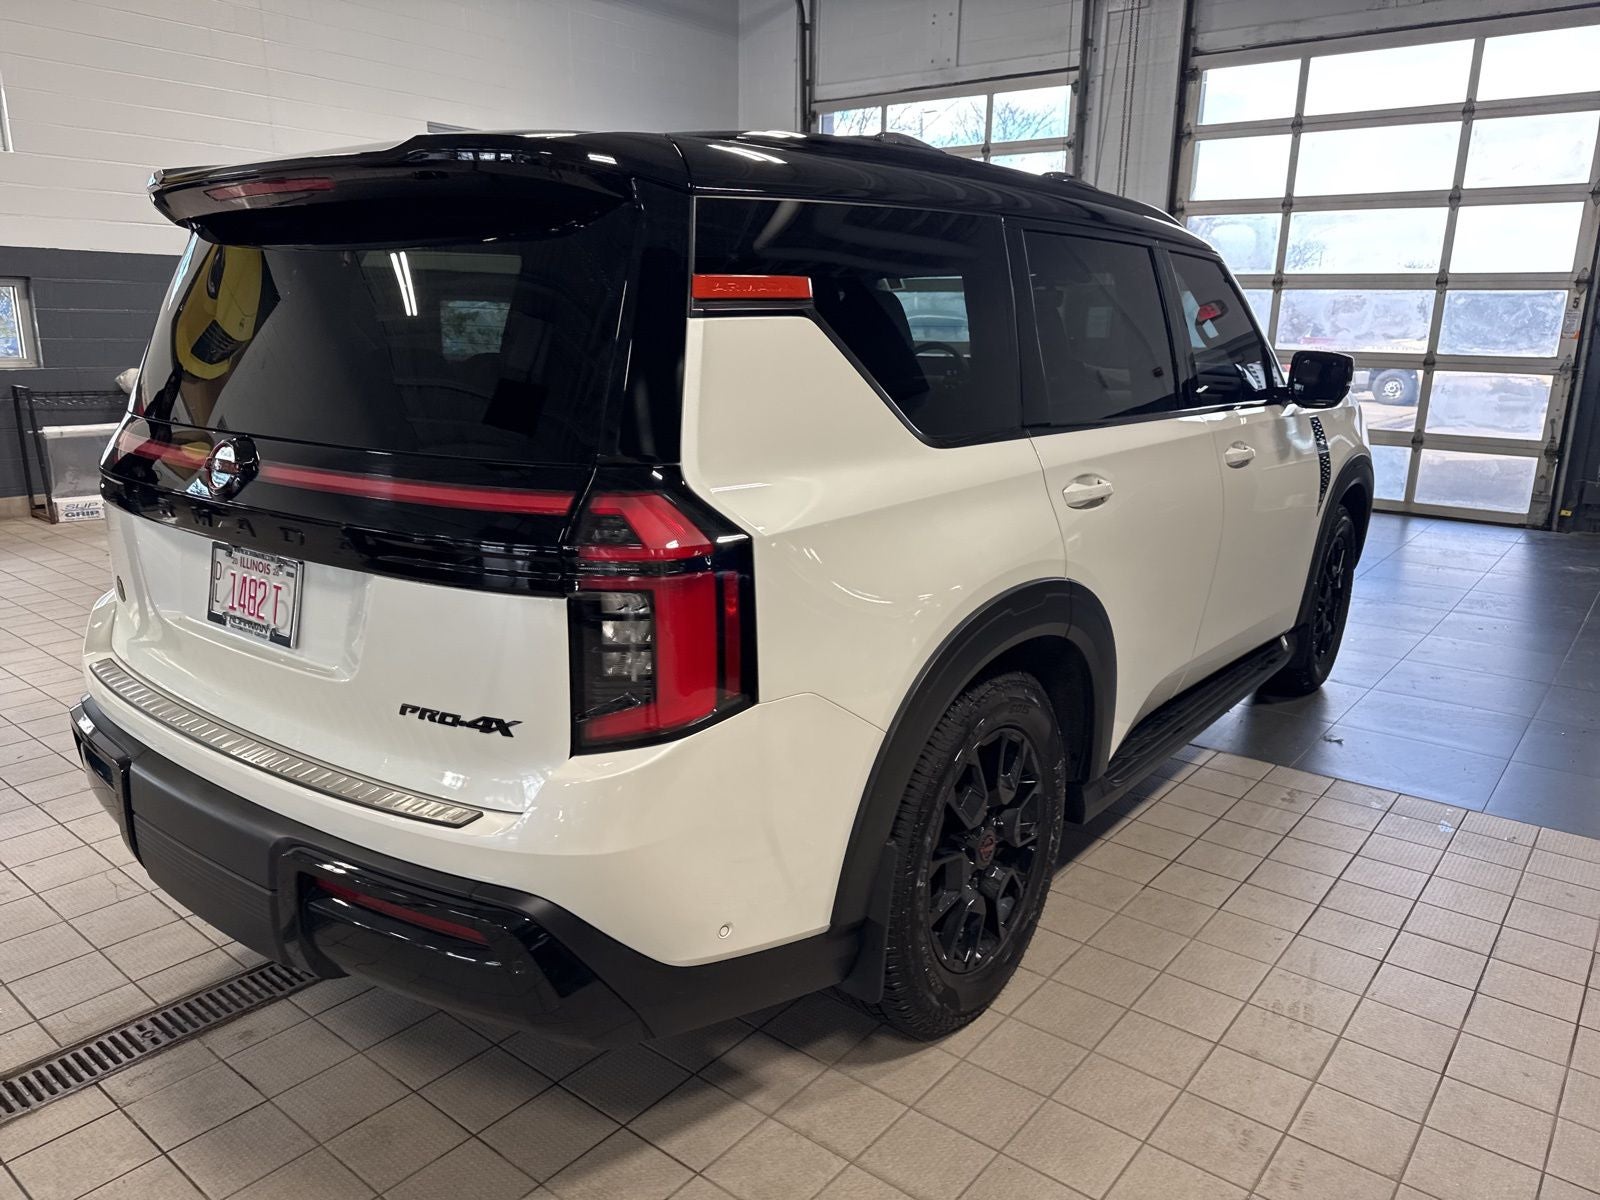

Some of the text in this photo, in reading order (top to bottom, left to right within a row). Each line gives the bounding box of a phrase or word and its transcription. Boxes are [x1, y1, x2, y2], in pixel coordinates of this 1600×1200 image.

[1572, 298, 1579, 308] 5
[240, 556, 271, 575] ILLINOIS
[229, 573, 266, 620] 1482
[398, 702, 523, 738] PRO-4X
